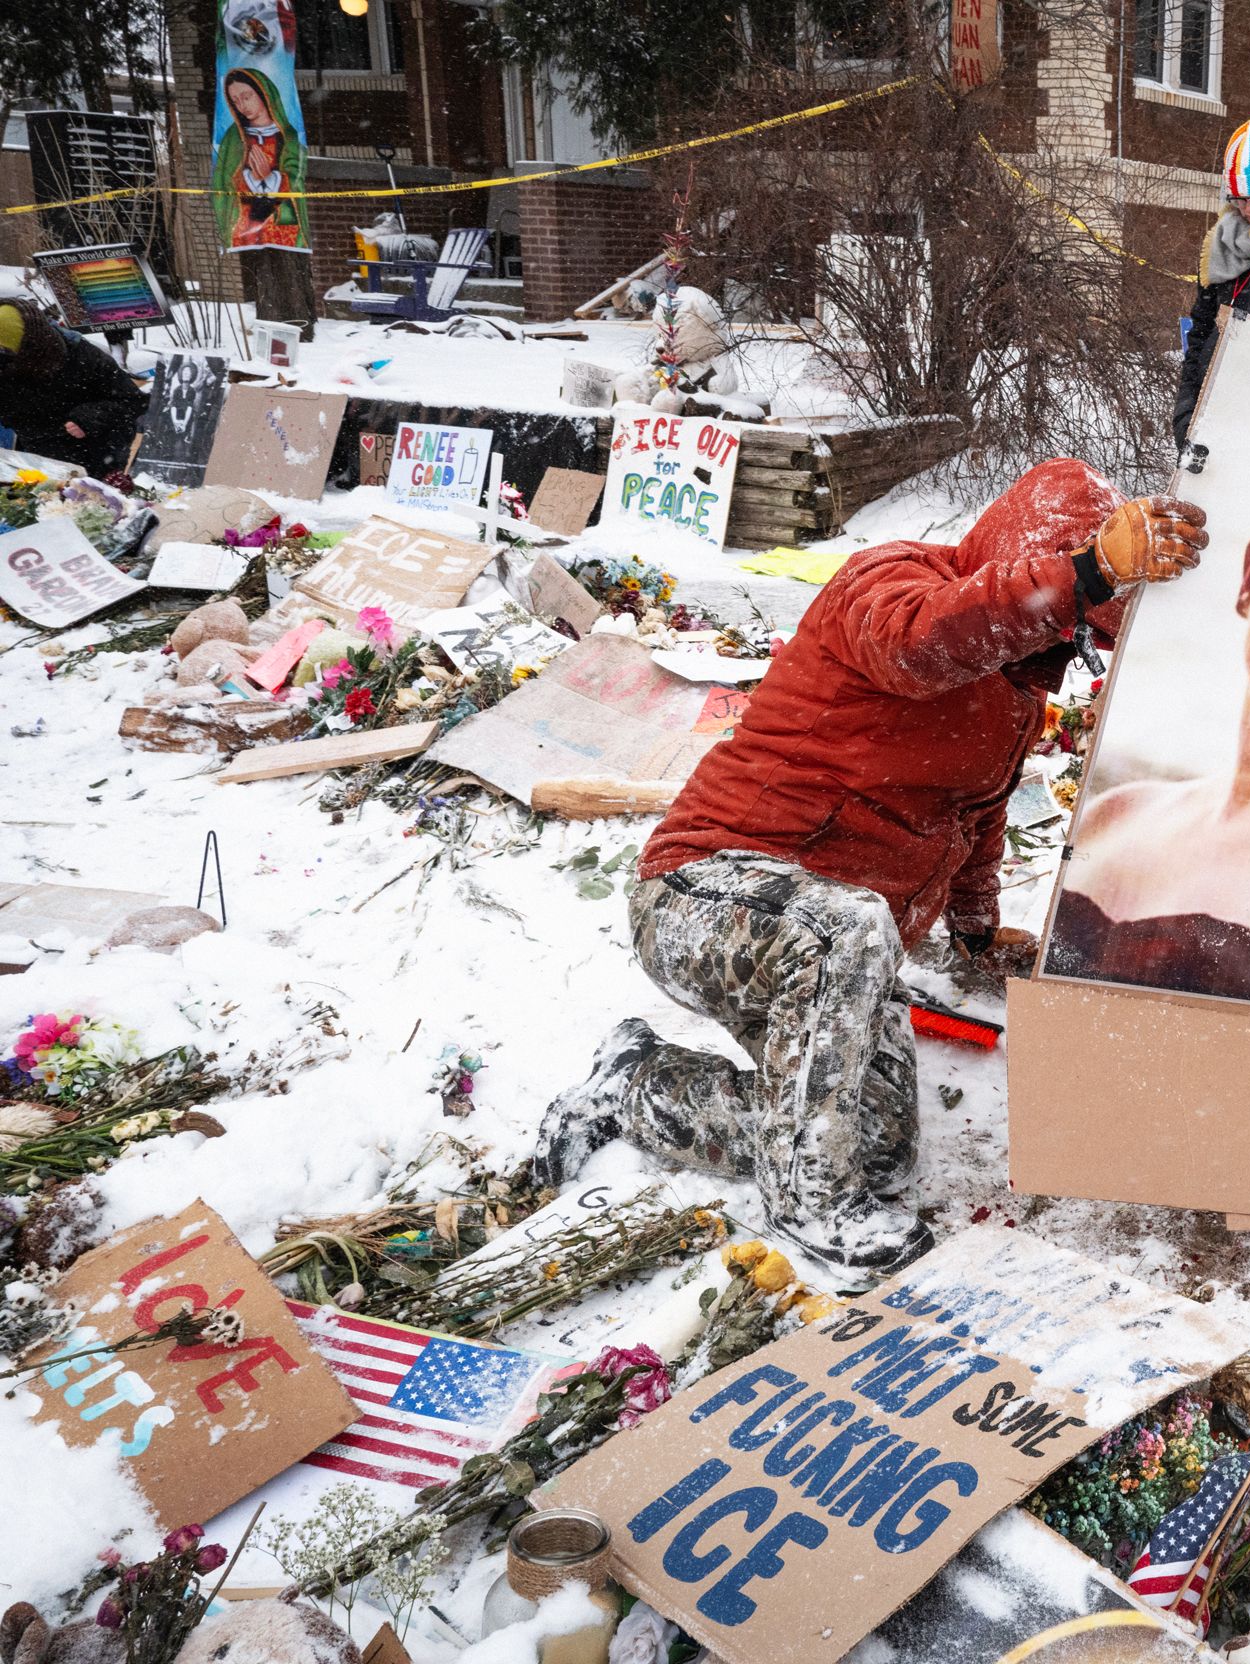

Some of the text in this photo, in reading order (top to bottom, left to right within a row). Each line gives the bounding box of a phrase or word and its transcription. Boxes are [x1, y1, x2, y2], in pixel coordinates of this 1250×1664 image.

[40, 248, 132, 266] Make the World Great!
[397, 427, 459, 463] RENEE
[630, 417, 740, 468] ICE OUT
[653, 452, 681, 475] for
[411, 463, 455, 487] GOOD
[621, 472, 719, 536] PEACE
[819, 1308, 884, 1343] TO
[952, 1380, 1089, 1458] SOME
[689, 1364, 980, 1555] FUCKING
[626, 1457, 829, 1627] ICE
